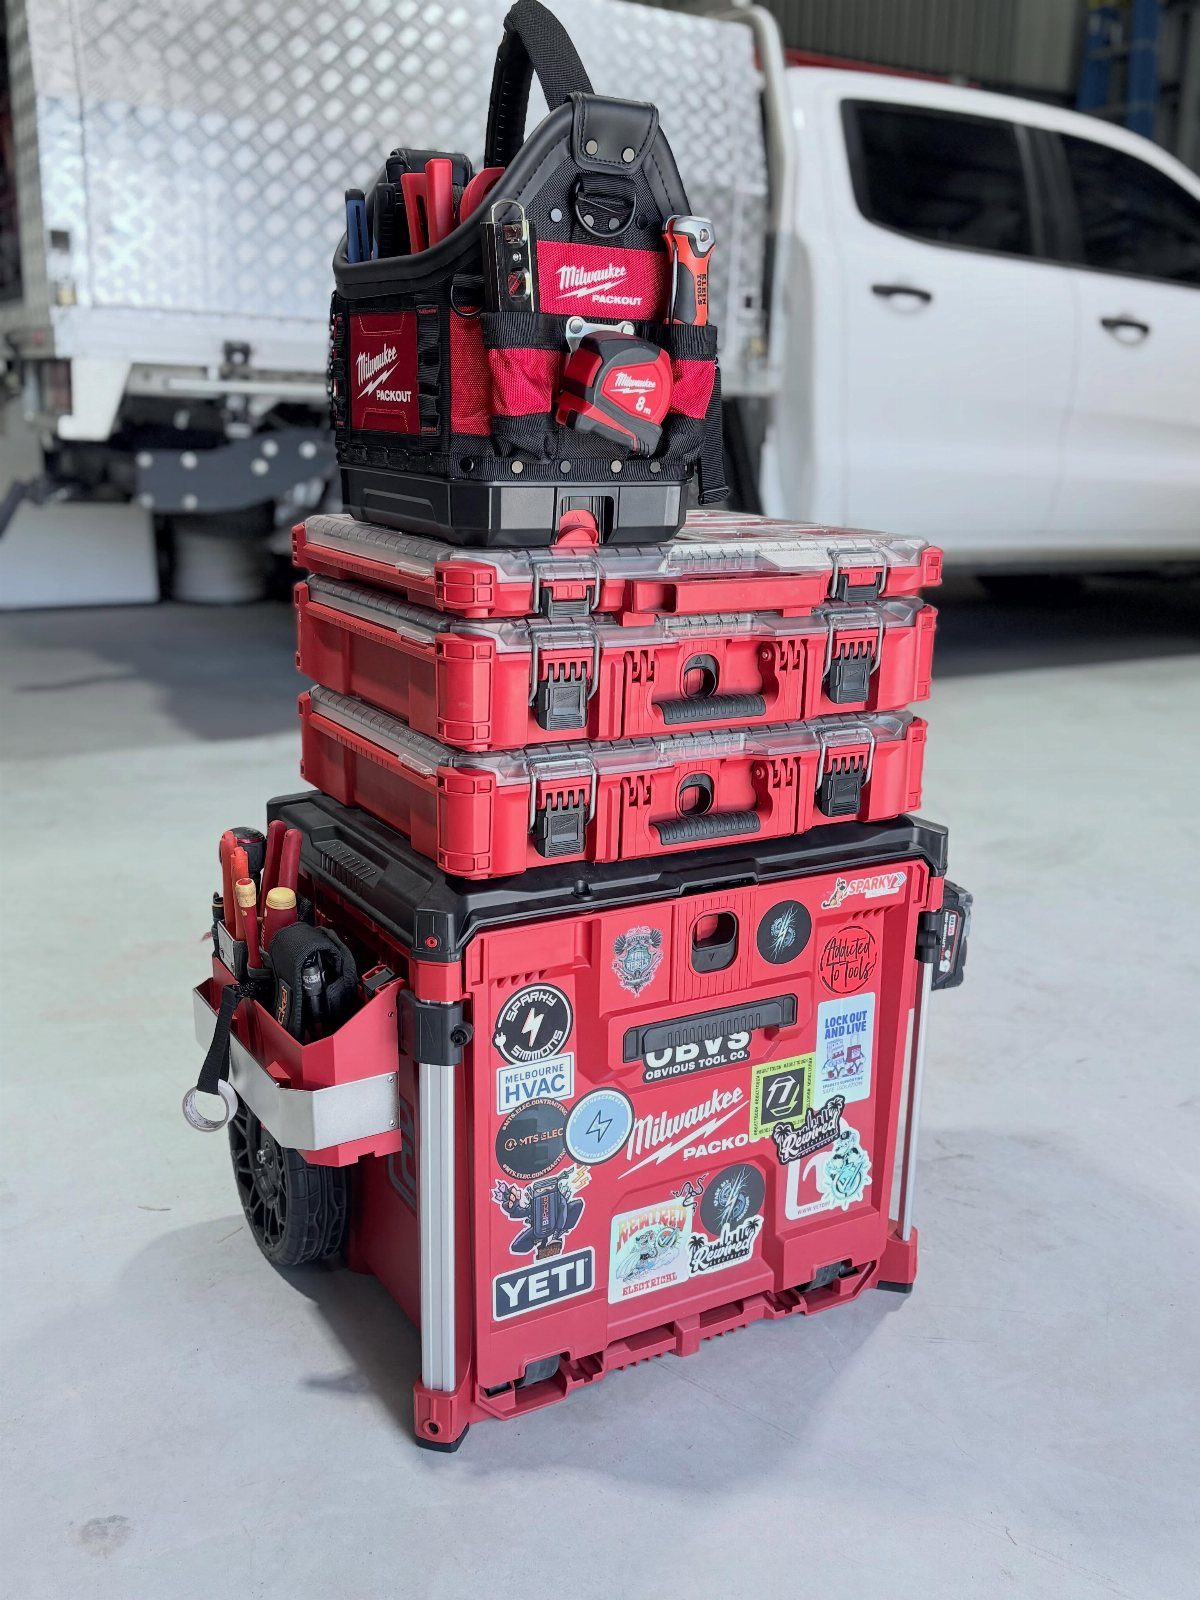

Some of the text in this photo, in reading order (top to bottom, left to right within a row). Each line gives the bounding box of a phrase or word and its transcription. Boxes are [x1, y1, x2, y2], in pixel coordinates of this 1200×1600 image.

[556, 263, 627, 297] Milwaukee
[592, 294, 642, 306] PACKOUT
[355, 343, 398, 386] Milwaukee
[615, 372, 656, 388] Milwaukee
[376, 389, 412, 402] PACKOUT
[826, 936, 871, 964] Addicted
[506, 991, 558, 1022] SPARKY
[825, 1010, 868, 1029] LOCK OUT
[824, 1020, 867, 1039] AND LIVE
[505, 1063, 565, 1084] MELBOURNE
[645, 1050, 748, 1080] OBVIOUS TOOL CO.
[506, 1074, 565, 1103] HVAC
[519, 1127, 564, 1146] MTS ELEC
[626, 1086, 744, 1161] Milwaukee
[499, 1257, 586, 1308] YETI
[622, 1272, 678, 1296] ELECTRICAL
